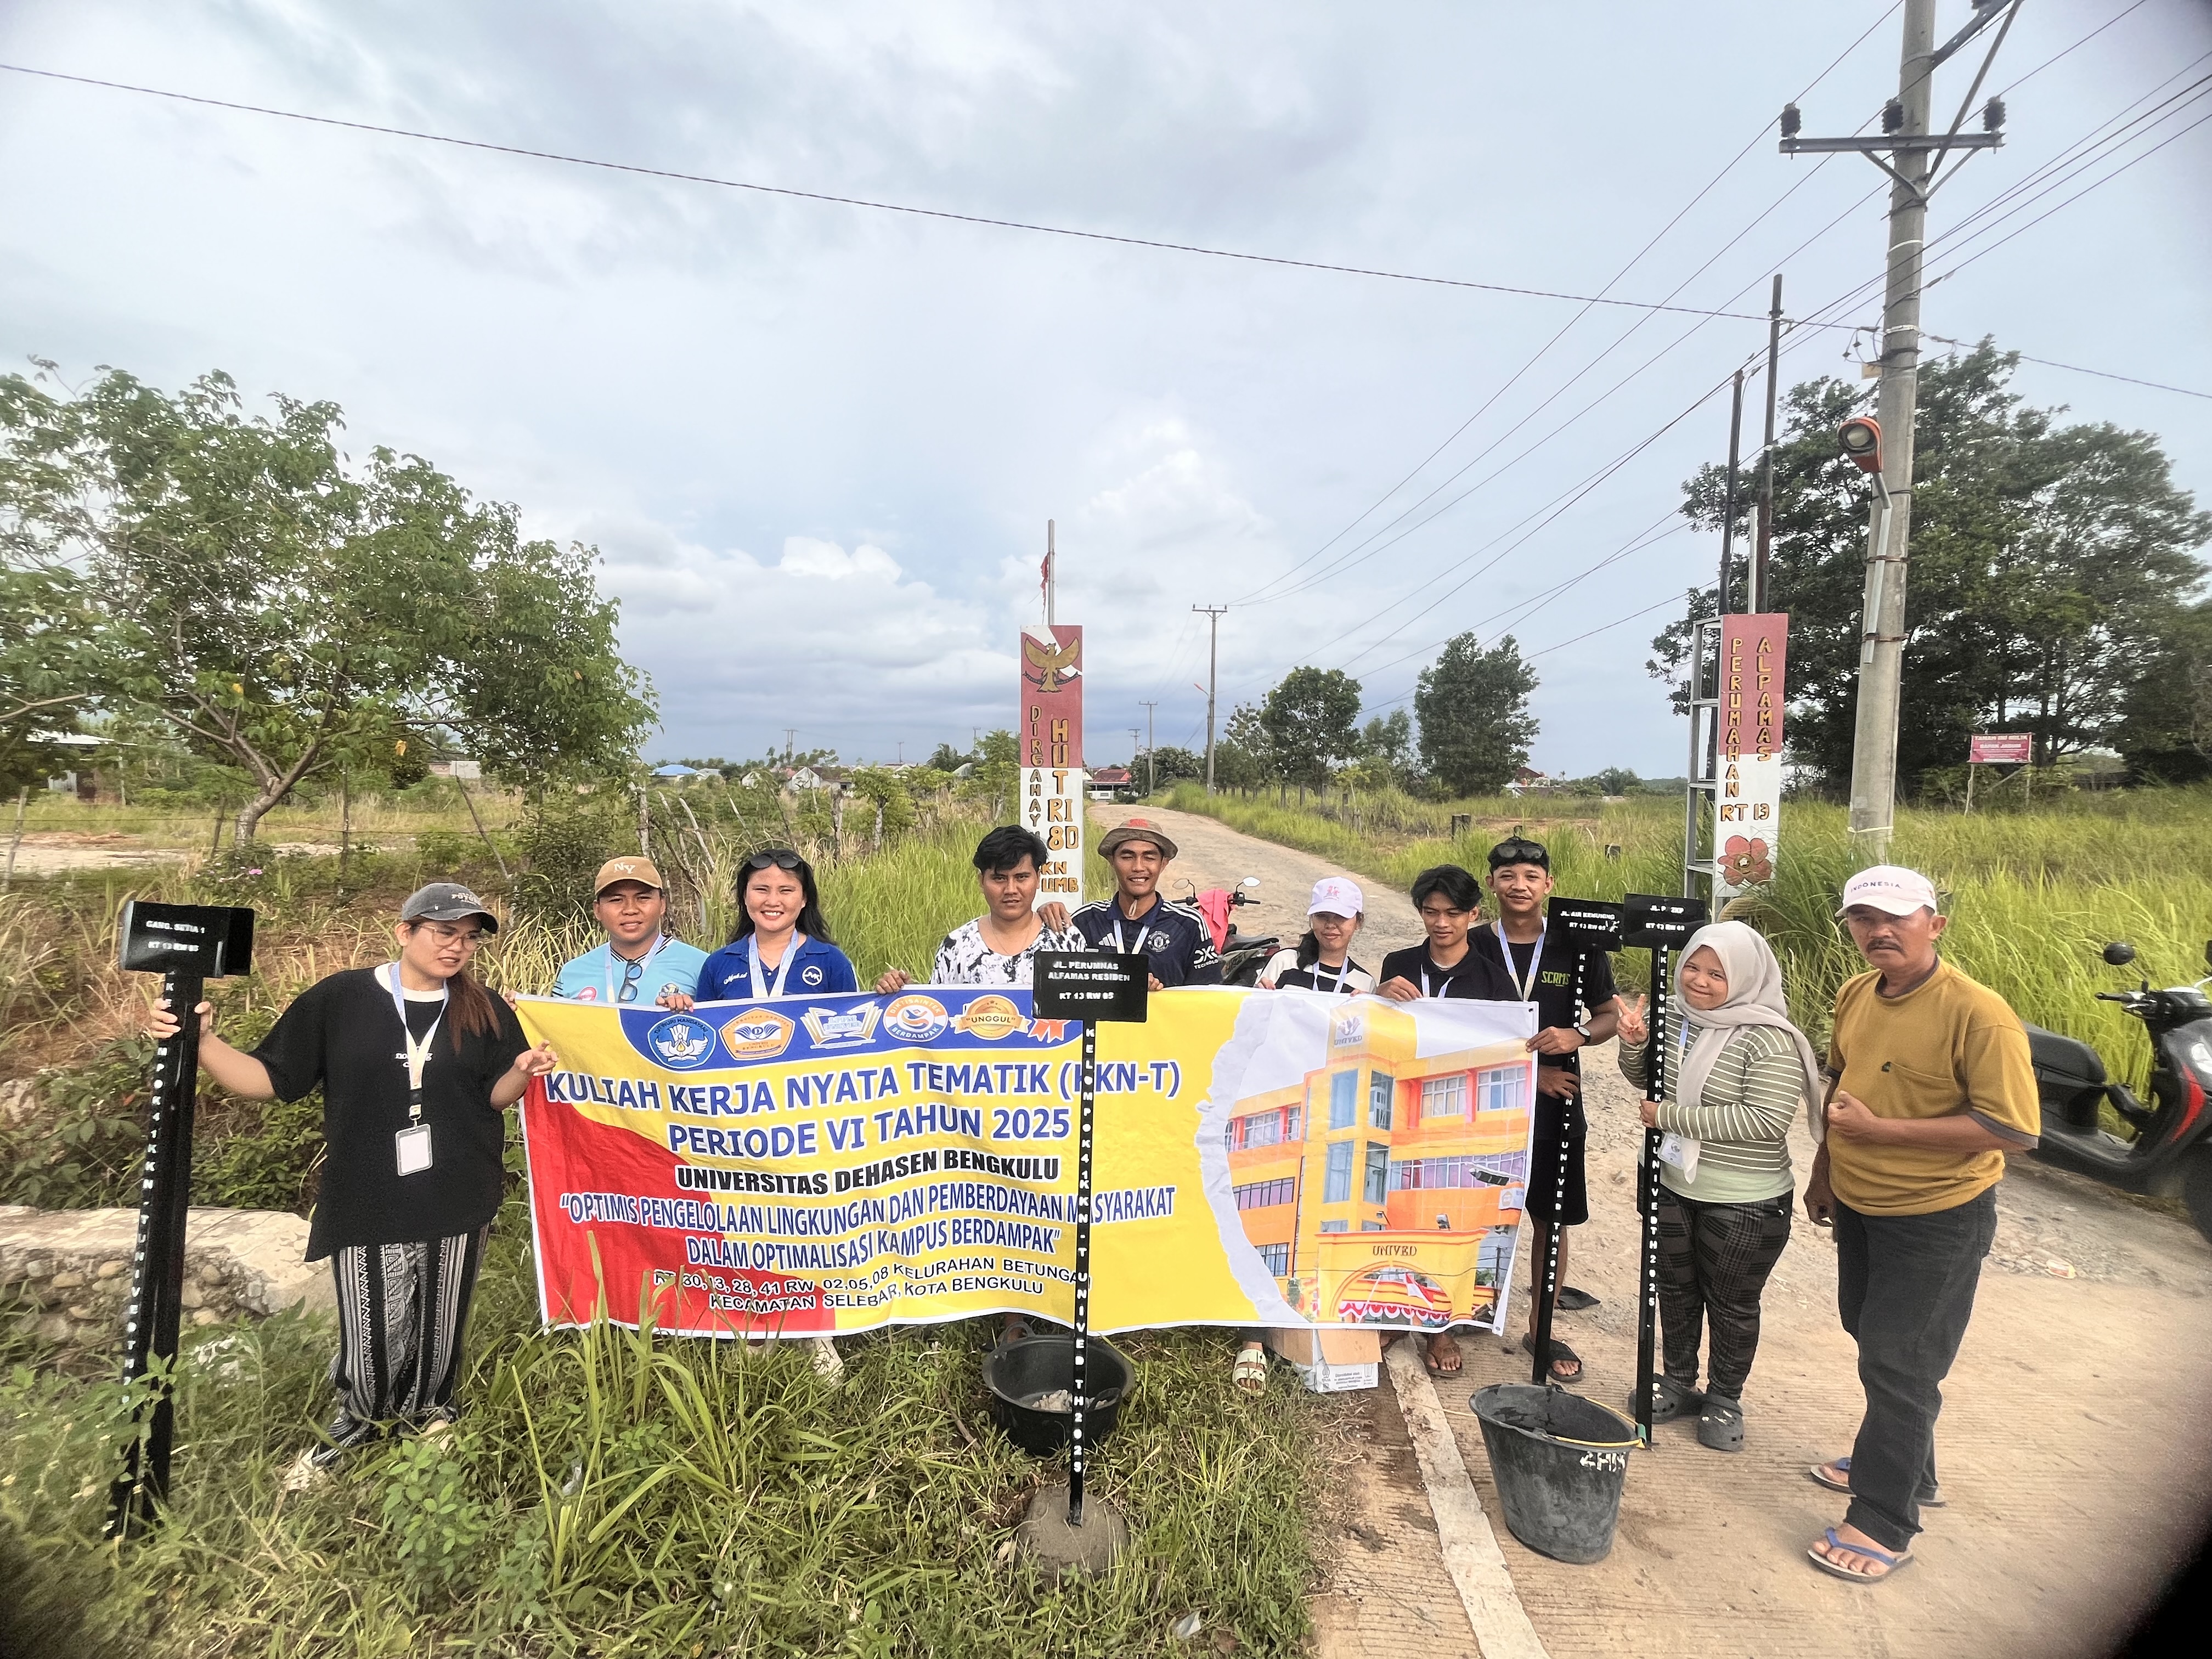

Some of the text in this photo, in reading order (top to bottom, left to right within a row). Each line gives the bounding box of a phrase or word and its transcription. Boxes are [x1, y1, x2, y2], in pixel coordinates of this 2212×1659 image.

[1757, 637, 1773, 761] ALPAMAS
[1725, 637, 1743, 798] PERUMAHAN
[1029, 704, 1045, 839] DIRGAHAY
[1051, 718, 1069, 795] HUT
[1047, 798, 1073, 822] RI
[1720, 803, 1770, 822] RT 13
[612, 862, 636, 874] NY
[1041, 877, 1079, 893] UMB
[1850, 881, 1902, 893] INDONESIA
[1048, 972, 1090, 980] ALFAMAS
[1069, 961, 1119, 970] PERUMNAS
[890, 998, 943, 1014] DIKTISAINTEK
[891, 1026, 940, 1039] BERDAMPAK
[548, 1074, 659, 1109] KULIAH
[670, 1083, 775, 1114] KERJA
[789, 1070, 899, 1108] NYATA
[907, 1063, 1050, 1096] TEMATIK
[669, 1105, 1070, 1157] PERIODE VI TAHUN 2025
[678, 1150, 1058, 1194] UNIVERSITAS DEHASEN BENGKULU
[641, 1198, 762, 1233] PENGELOLAAN
[769, 1198, 885, 1235] LINGKUNGAN
[889, 1190, 926, 1220] DAN
[929, 1186, 1062, 1221] PEMBERDAYAAN
[1068, 1188, 1175, 1224] MSYARAKAT
[688, 1238, 749, 1266] DALAM
[753, 1237, 873, 1269] OPTIMALISASI
[878, 1221, 947, 1255] KAMPUS
[1372, 1244, 1418, 1257] UNIVED
[787, 1281, 814, 1293] RW
[894, 1258, 995, 1279] KELURAHAN
[1003, 1260, 1091, 1289] BETUNGA
[710, 1295, 815, 1313] KECAMATAN
[905, 1281, 947, 1296] KOTA
[952, 1278, 1043, 1295] BENGKULU
